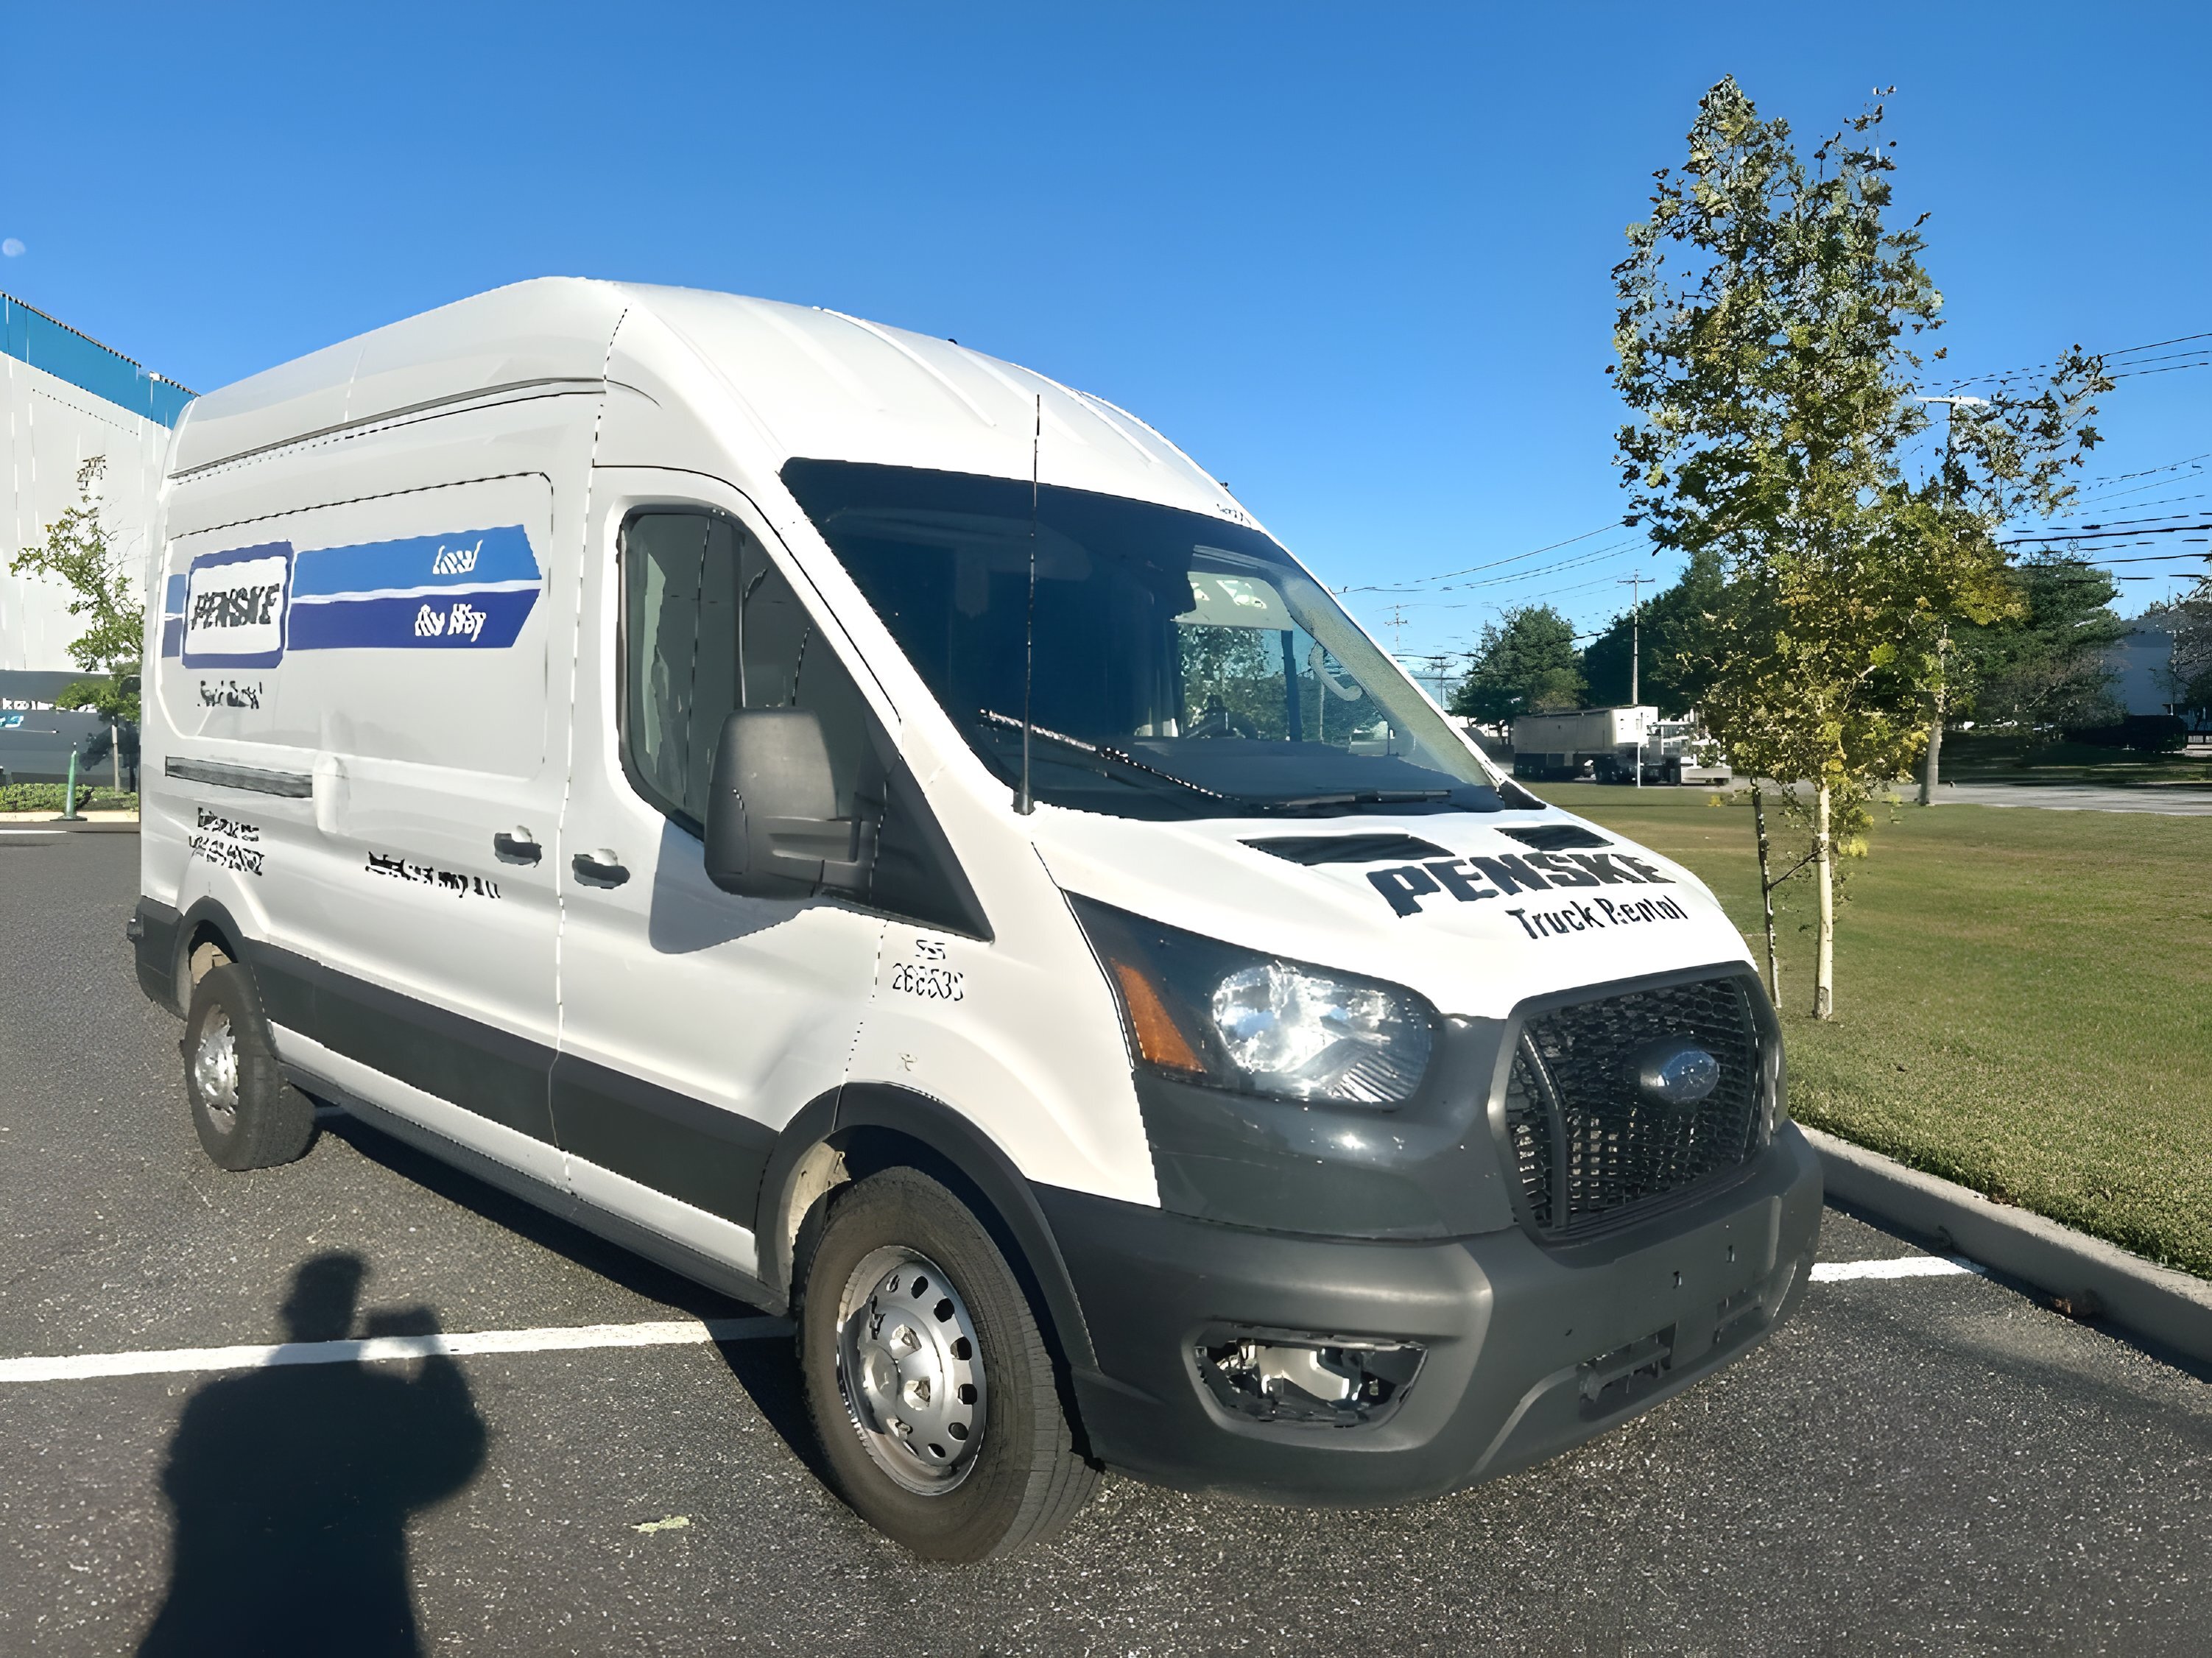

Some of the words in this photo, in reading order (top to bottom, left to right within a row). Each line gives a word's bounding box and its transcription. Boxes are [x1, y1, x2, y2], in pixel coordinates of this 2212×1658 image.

[1366, 853, 1677, 919] PENSKE
[1505, 900, 1605, 939] Truck
[1593, 895, 1689, 925] Rental
